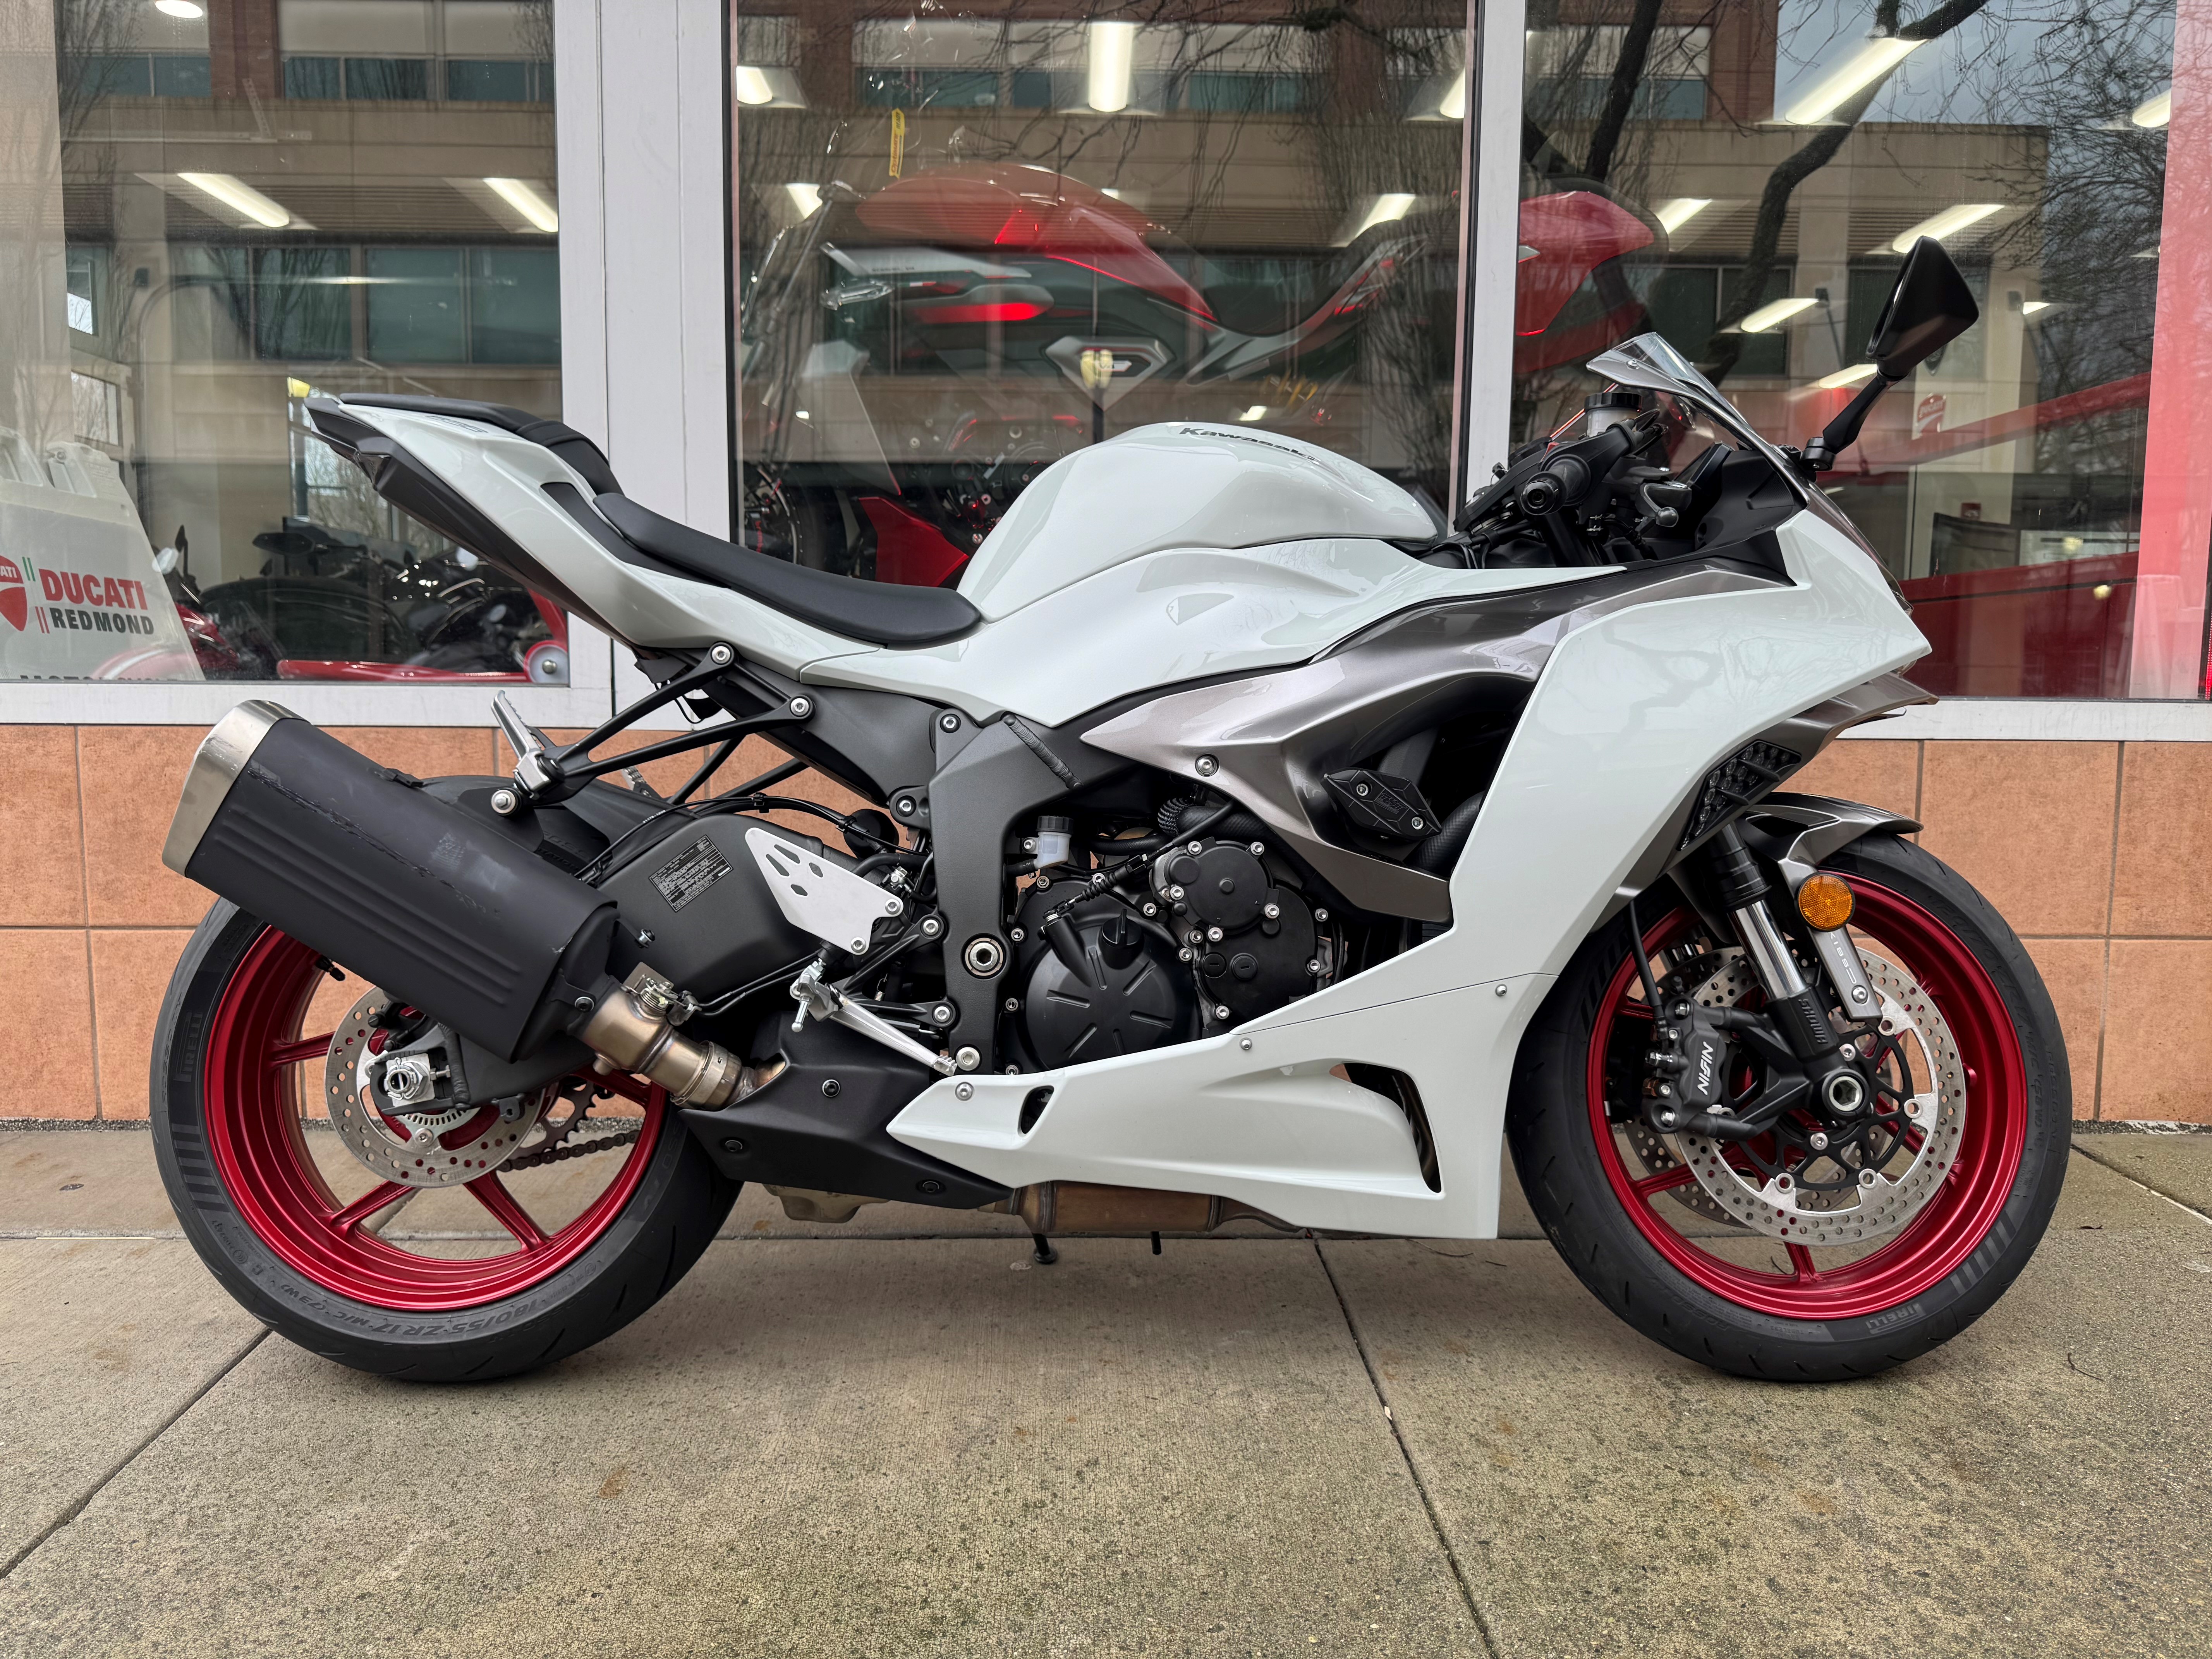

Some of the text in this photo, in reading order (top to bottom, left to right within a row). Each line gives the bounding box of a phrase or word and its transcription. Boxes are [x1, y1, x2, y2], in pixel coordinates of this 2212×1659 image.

[1179, 428, 1321, 464] Kawasaki
[39, 568, 148, 610] DUCATI
[49, 607, 154, 635] REDMOND
[1798, 998, 1828, 1044] SHOWA
[173, 1010, 203, 1082] PIRELLI
[1697, 1041, 1714, 1096] NISSIN
[452, 1299, 538, 1334] 180/55
[1865, 1303, 1927, 1334] PIRELLI
